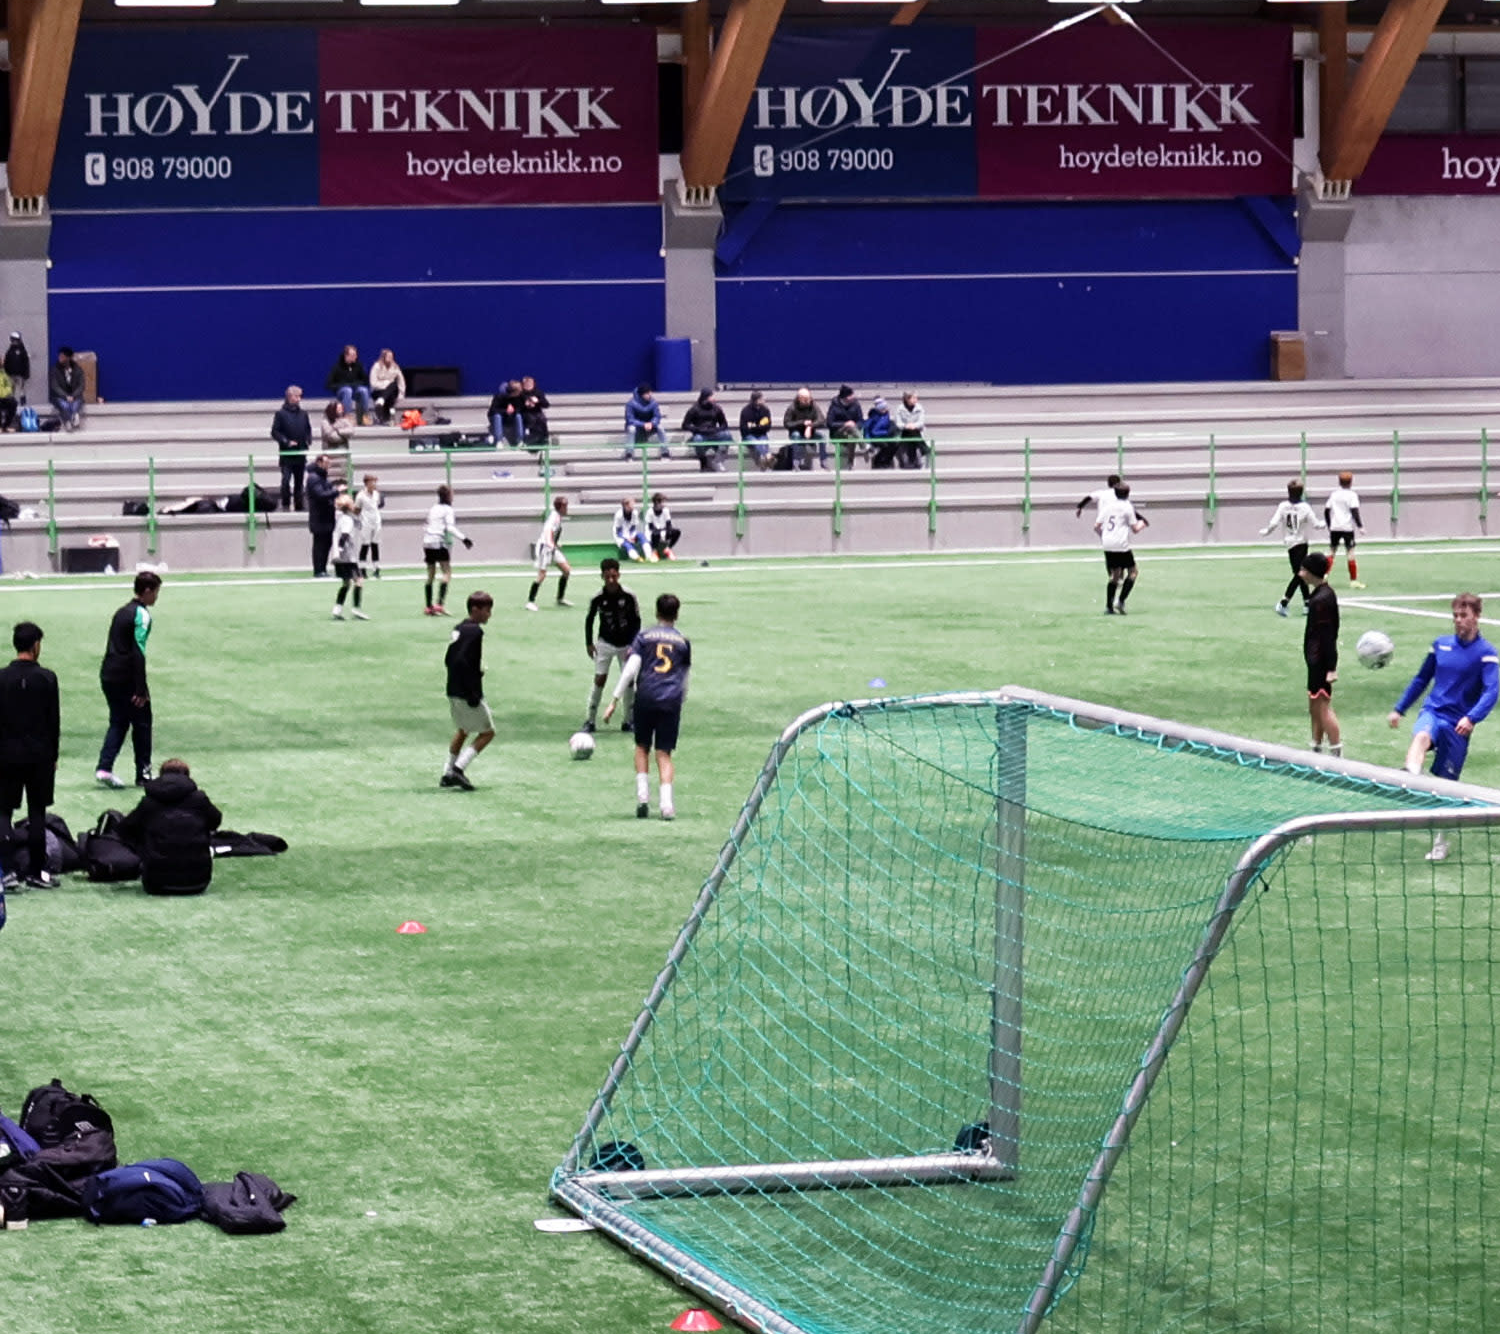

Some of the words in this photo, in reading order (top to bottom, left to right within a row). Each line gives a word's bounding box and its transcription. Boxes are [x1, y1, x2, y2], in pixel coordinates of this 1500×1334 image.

[85, 55, 314, 137] HØYDE
[325, 87, 620, 139] TEKNIKK
[753, 48, 972, 129] HØYDE
[982, 83, 1259, 133] TEKNIKK
[112, 157, 154, 180] 908
[162, 155, 232, 180] 79000
[407, 149, 623, 182] hoydeteknikk.no
[779, 149, 820, 172] 908
[827, 147, 894, 171] 79000
[1059, 143, 1262, 174] hoydeteknikk.no
[653, 642, 674, 674] 5
